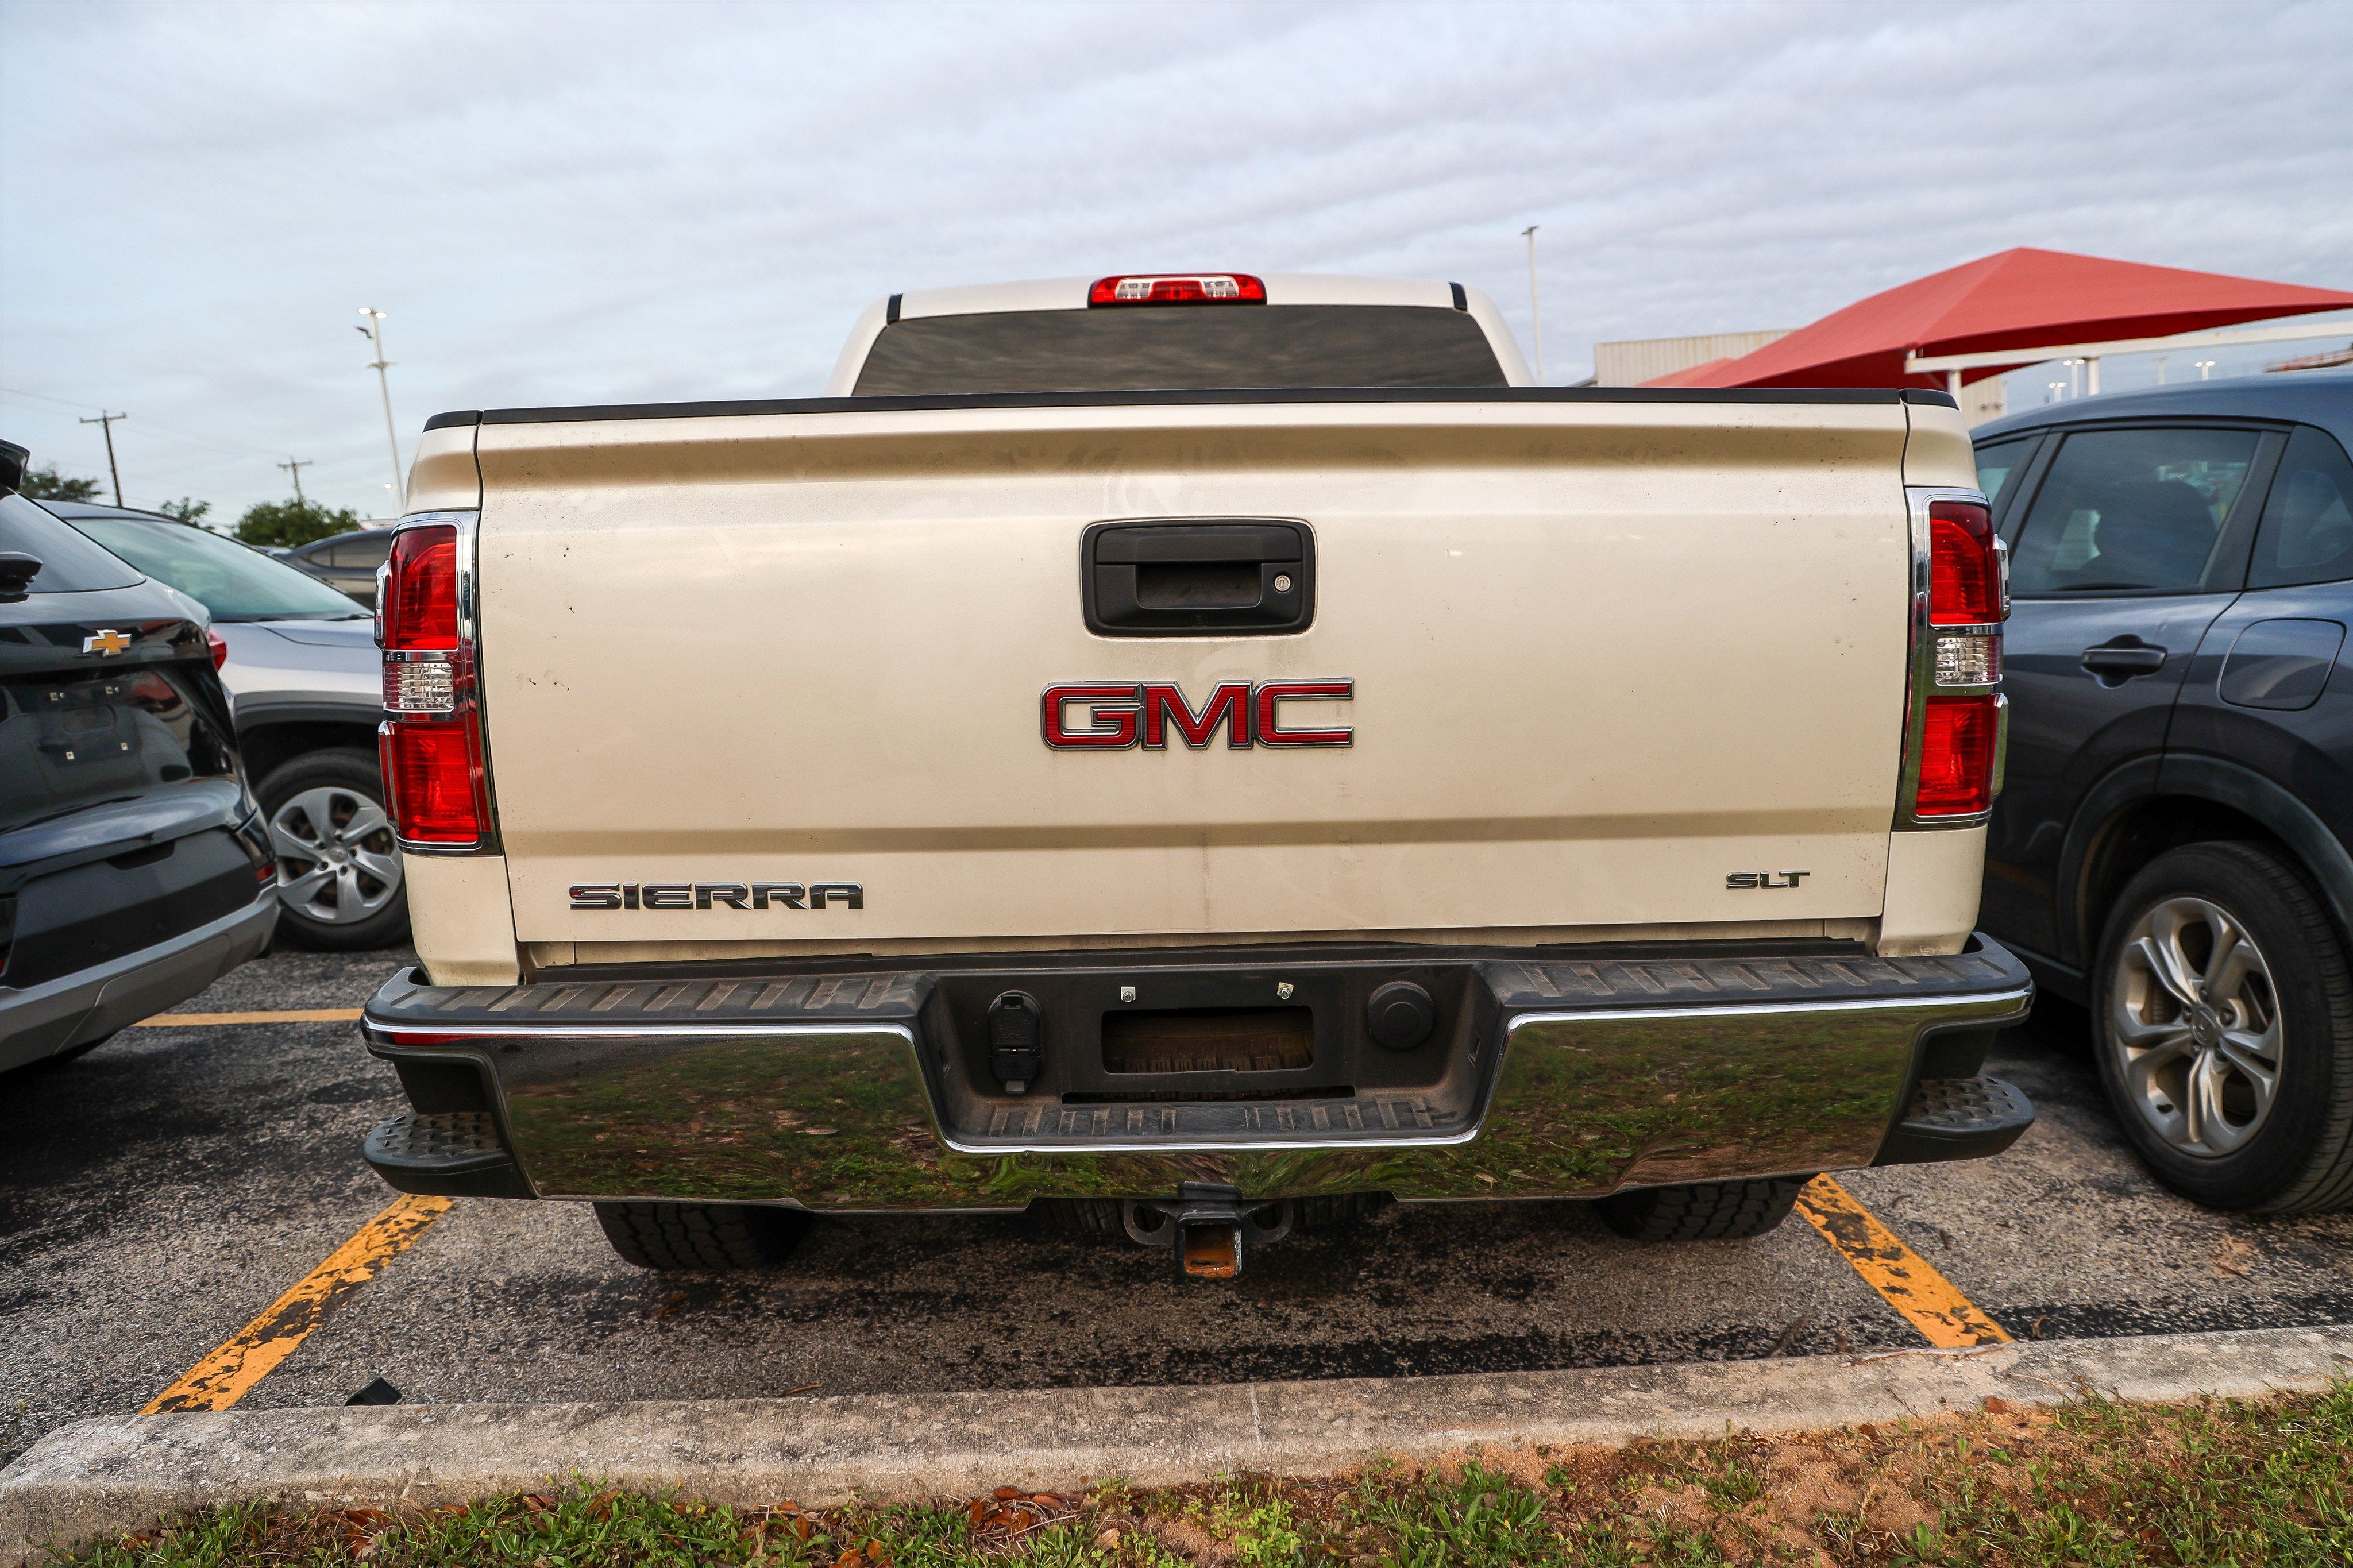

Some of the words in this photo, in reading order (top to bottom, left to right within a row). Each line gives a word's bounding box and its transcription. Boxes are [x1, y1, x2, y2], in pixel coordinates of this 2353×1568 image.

[1040, 678, 1354, 751] GMC
[1726, 870, 1811, 890] SLT
[569, 882, 864, 910] SIERRA
